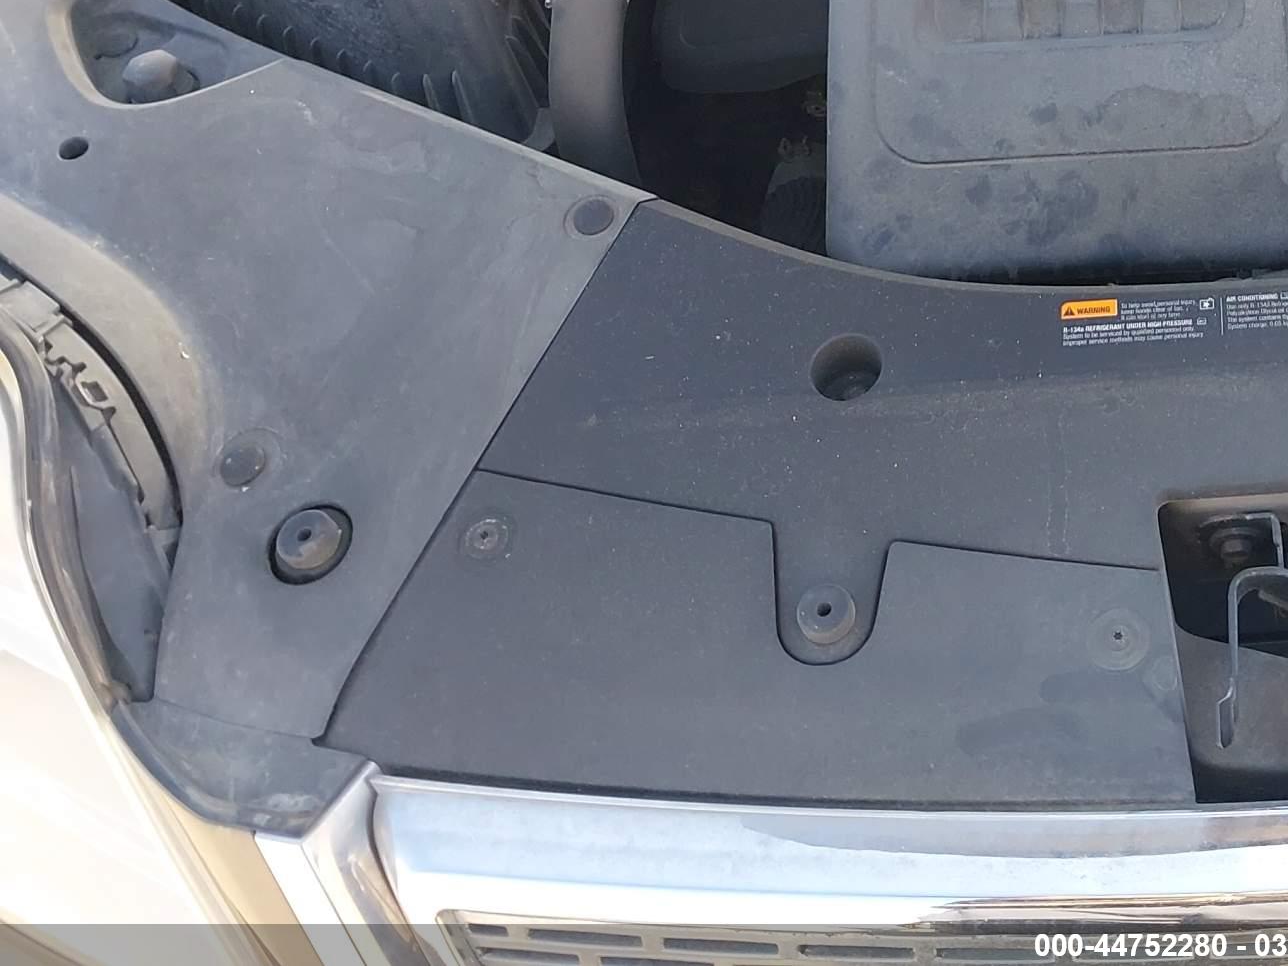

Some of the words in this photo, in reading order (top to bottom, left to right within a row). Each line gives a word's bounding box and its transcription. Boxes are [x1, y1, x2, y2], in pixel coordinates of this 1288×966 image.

[1238, 293, 1278, 301] CONDITIONING
[1076, 305, 1110, 315] WARNING
[1063, 326, 1084, 334] R-134a
[1086, 323, 1125, 332] REFRIGERANT
[1126, 321, 1146, 329] UNDER
[1148, 320, 1161, 328] HIGH
[1163, 318, 1193, 327] PRESSURE
